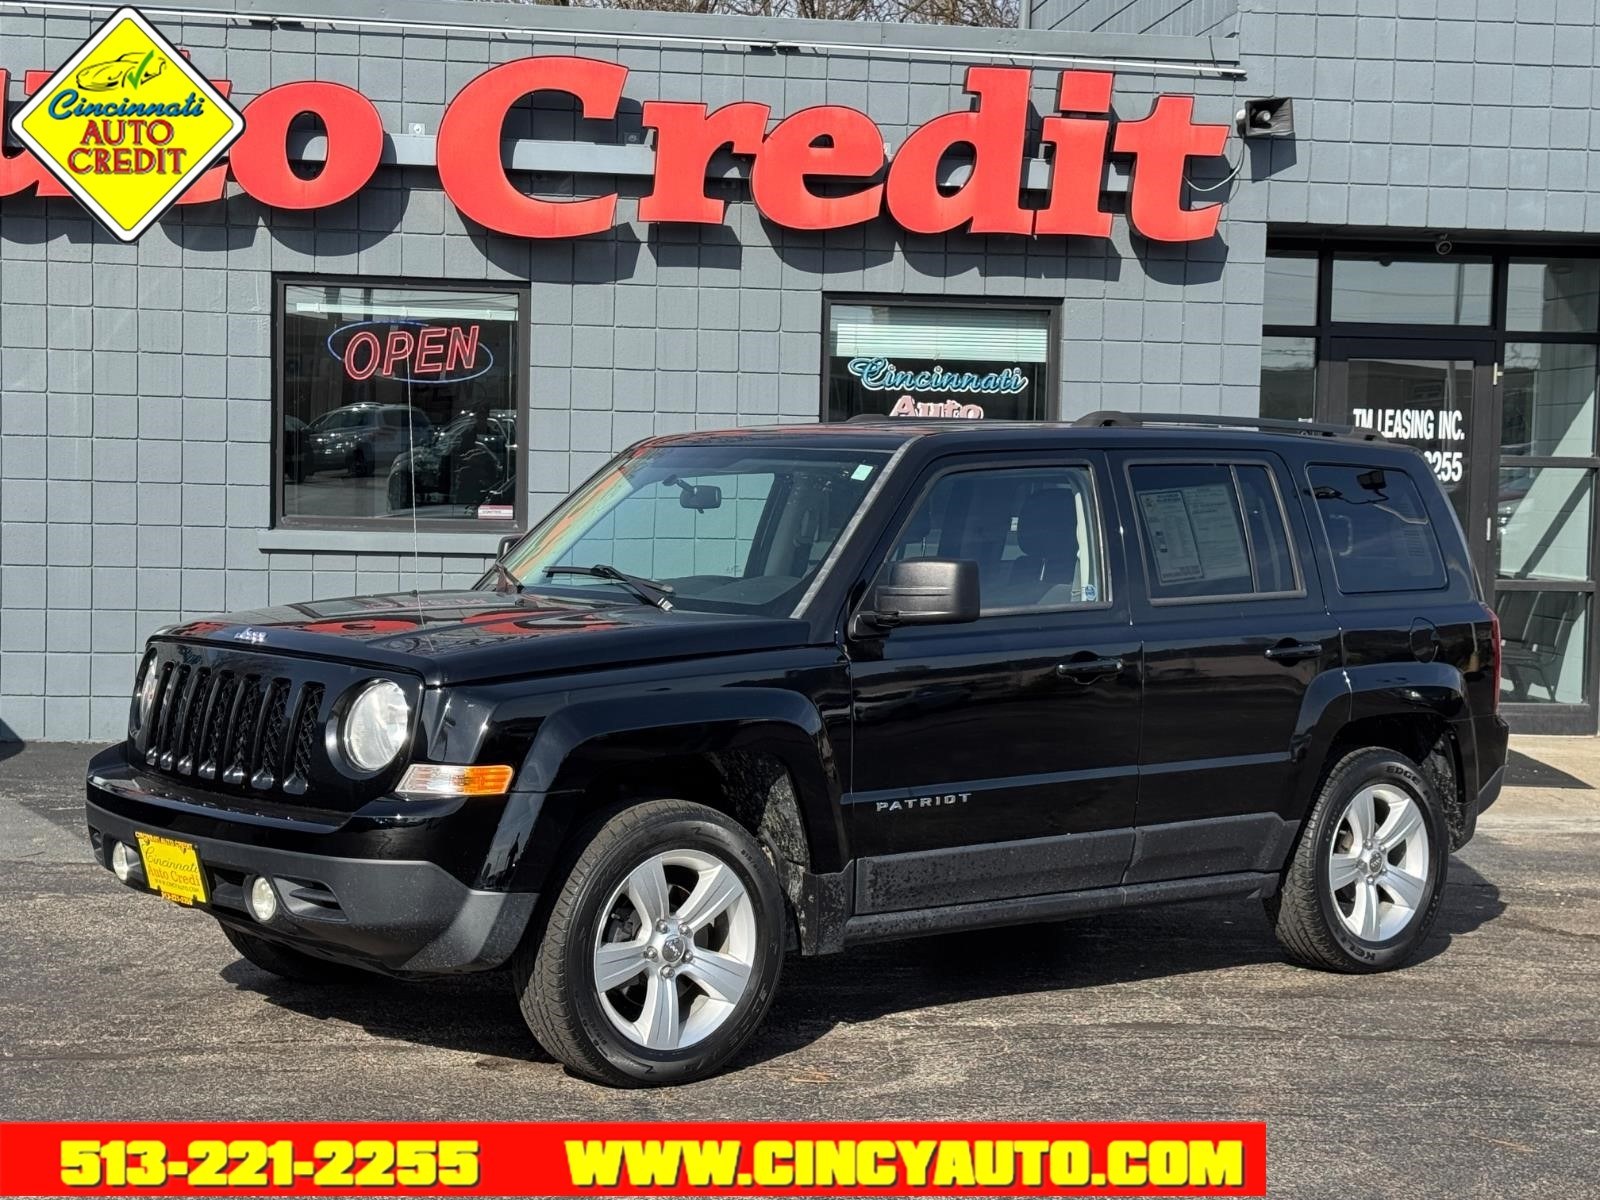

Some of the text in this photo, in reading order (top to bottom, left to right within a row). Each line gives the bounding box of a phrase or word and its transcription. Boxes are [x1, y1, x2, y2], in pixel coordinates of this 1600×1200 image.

[436, 56, 1230, 242] Credit
[344, 325, 480, 381] OPEN
[848, 357, 1029, 393] Cincinnati
[889, 395, 984, 419] Auto
[1353, 408, 1465, 441] TM LEASING INC.
[876, 793, 972, 812] PATRIOT
